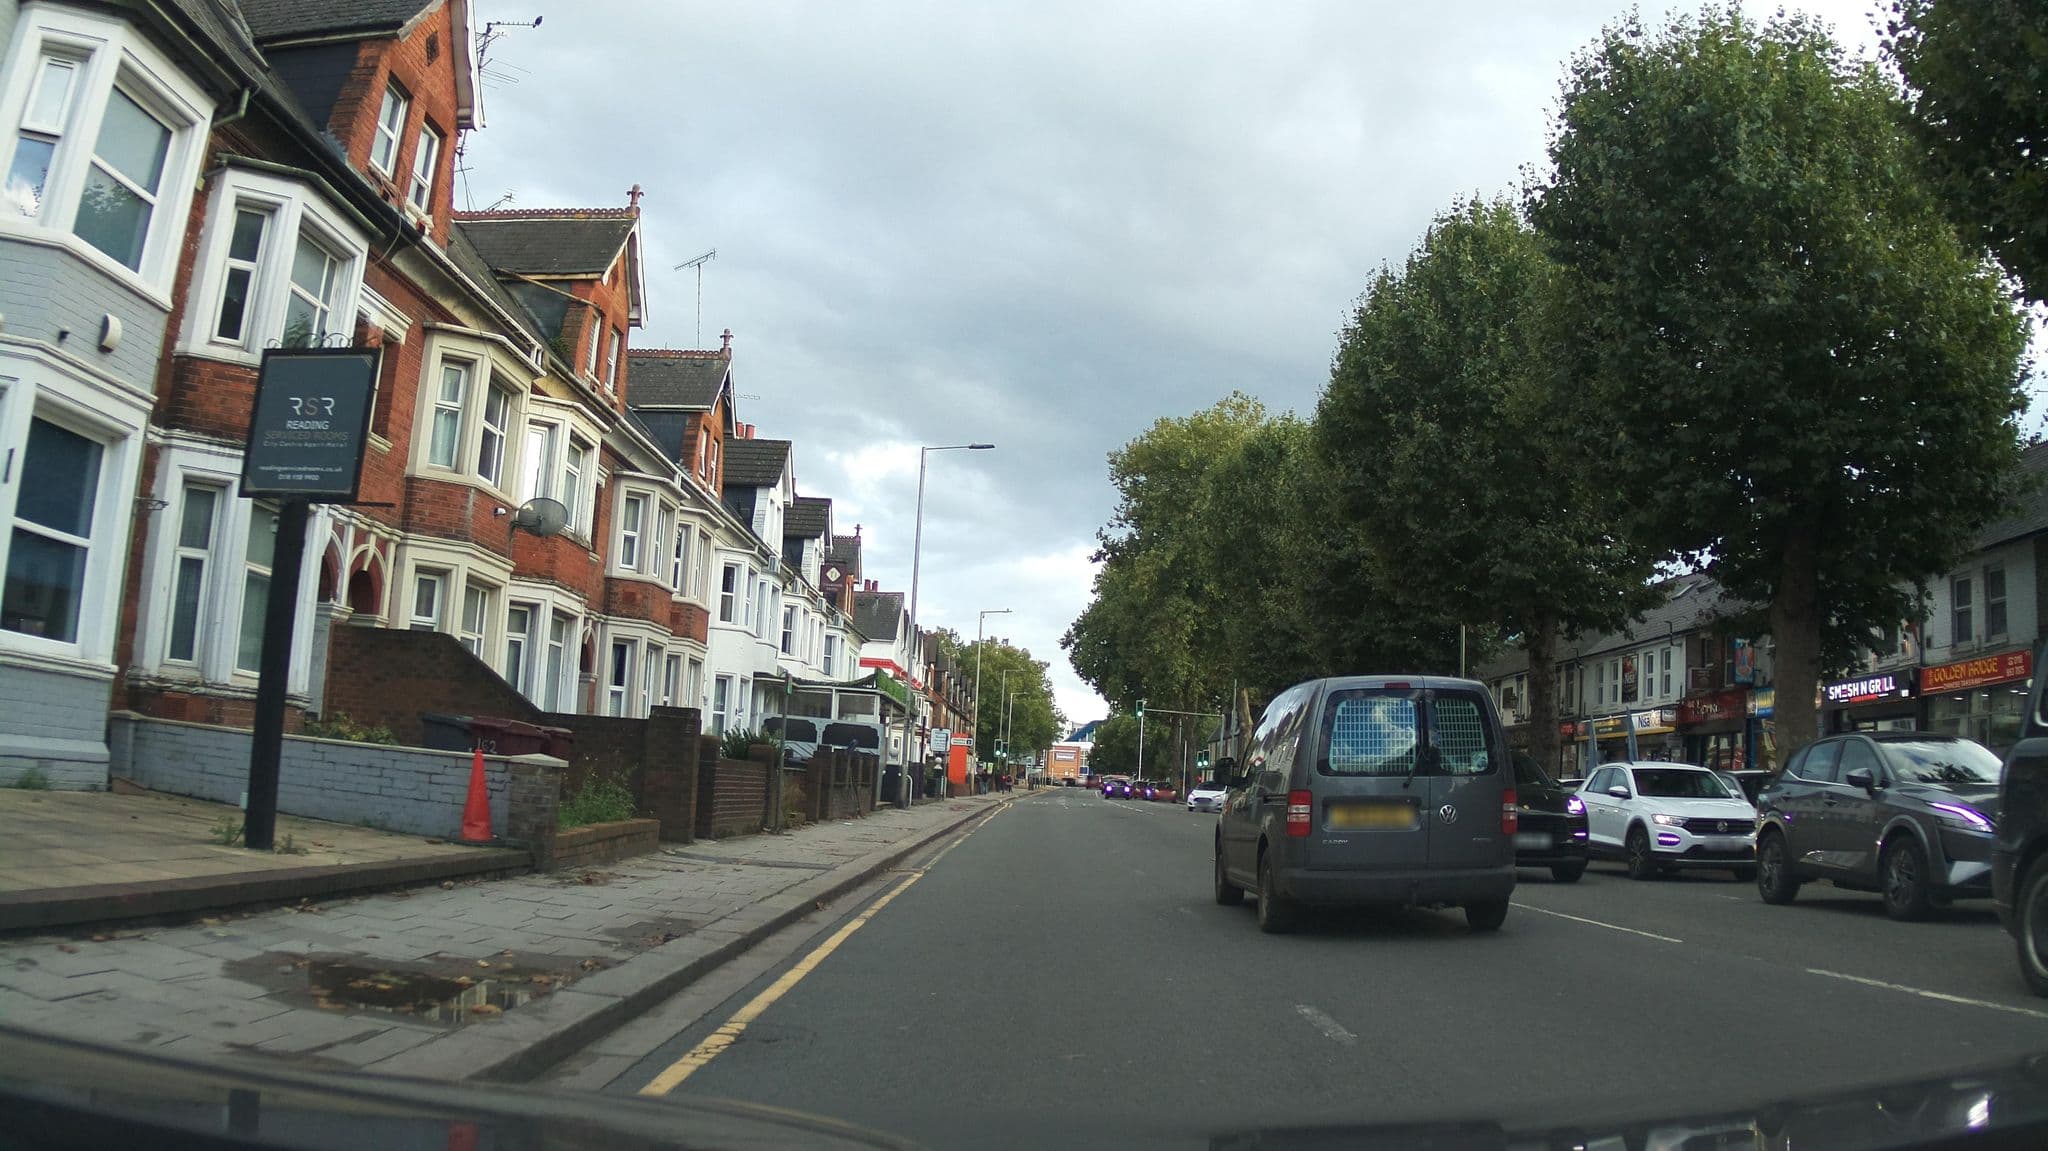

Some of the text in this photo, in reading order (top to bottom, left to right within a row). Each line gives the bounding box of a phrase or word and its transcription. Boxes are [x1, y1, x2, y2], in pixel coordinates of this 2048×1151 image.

[288, 397, 335, 415] RSR
[286, 420, 330, 430] READING
[1934, 664, 1966, 682] GOLDEN
[1860, 680, 1868, 695] N
[1868, 676, 1896, 693] GRILL
